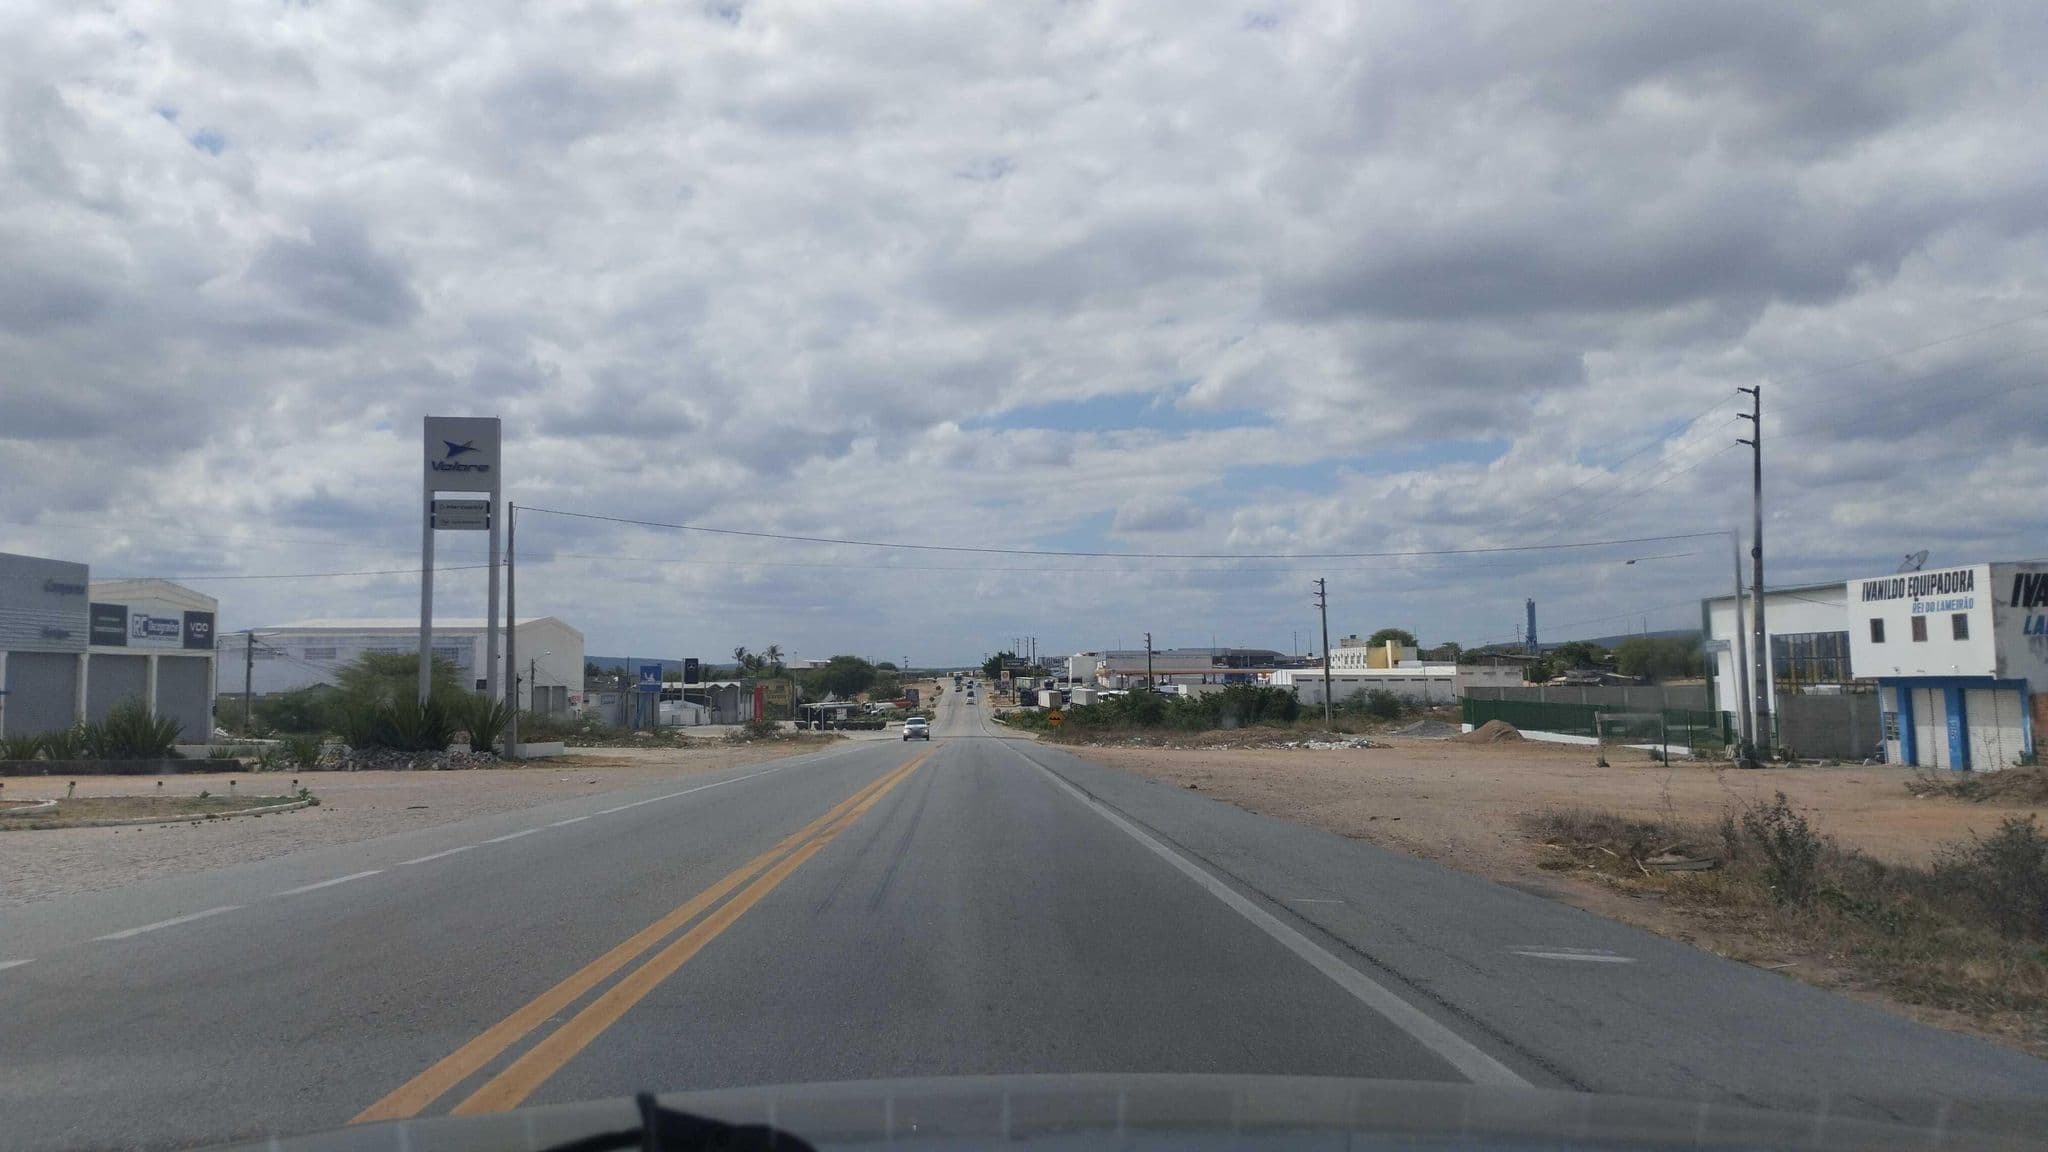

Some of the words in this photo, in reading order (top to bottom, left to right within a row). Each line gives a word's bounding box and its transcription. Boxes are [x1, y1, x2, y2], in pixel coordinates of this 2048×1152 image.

[1862, 578, 1905, 602] IVANILDO
[1907, 569, 1975, 600] EQUIPADORA
[1912, 602, 1925, 614] REI
[1925, 601, 1936, 613] DO
[1936, 596, 1975, 612] LAMEIRÃO
